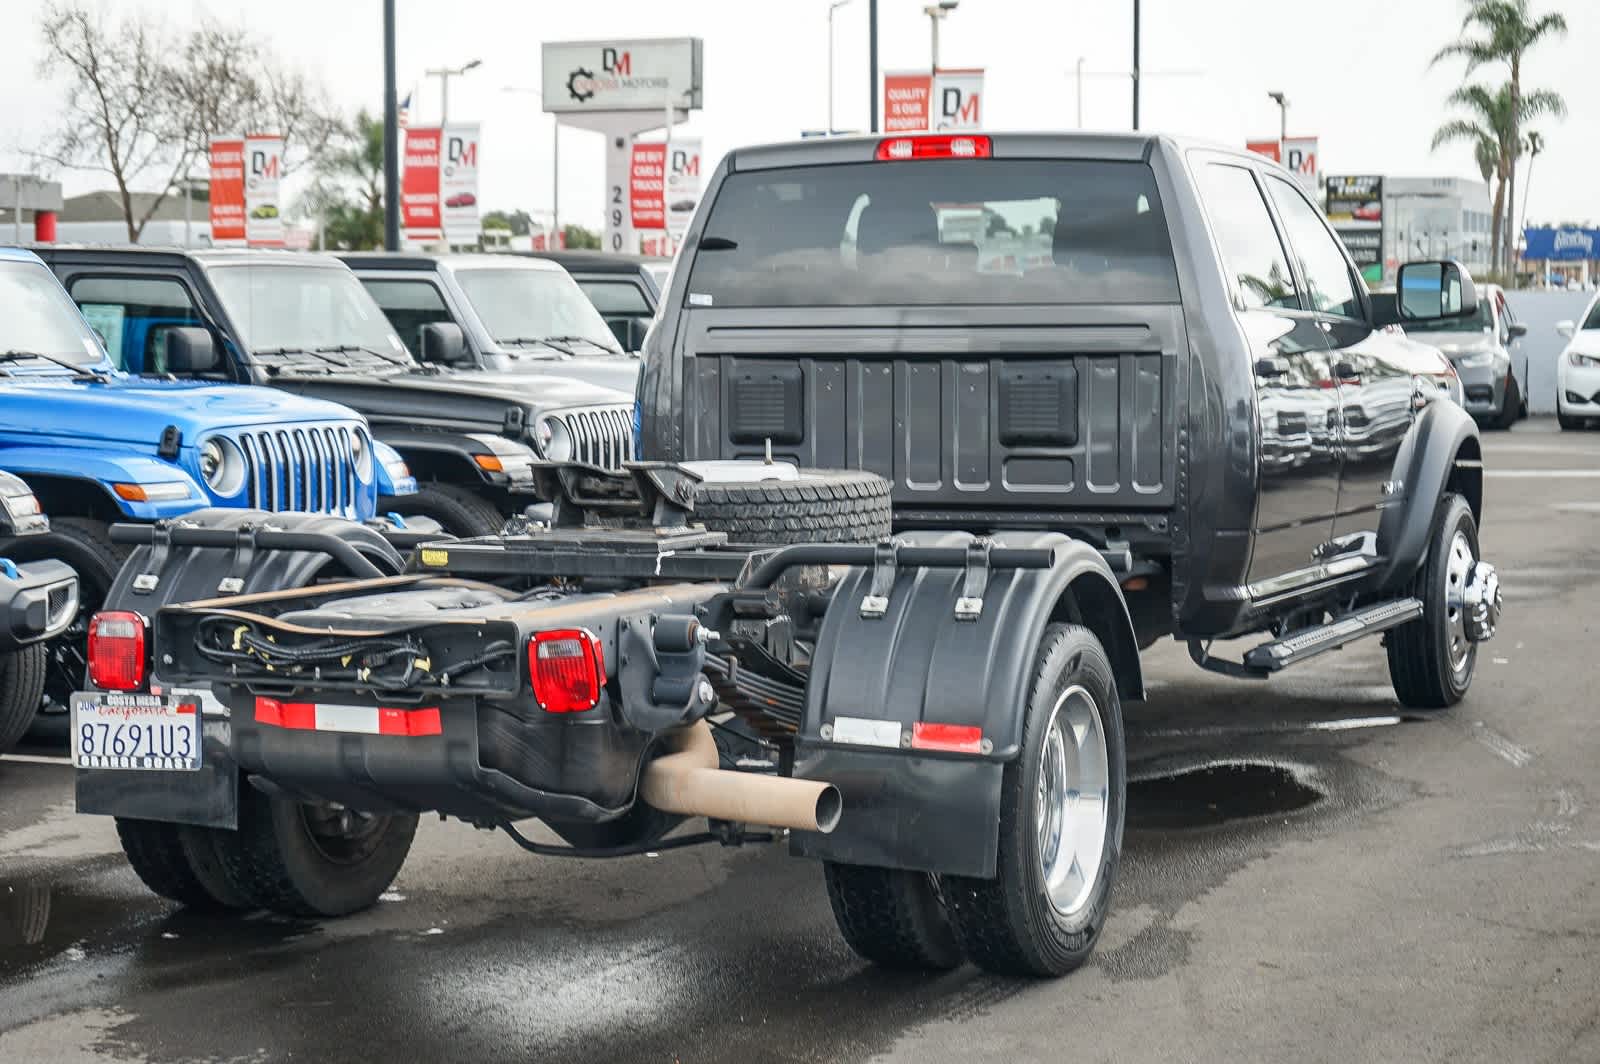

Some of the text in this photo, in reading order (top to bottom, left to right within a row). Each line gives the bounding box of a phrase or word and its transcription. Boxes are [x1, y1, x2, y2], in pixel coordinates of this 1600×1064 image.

[602, 48, 632, 76] DM
[887, 87, 927, 100] QUALITY
[942, 87, 978, 124] DM
[252, 151, 277, 179] DM
[448, 137, 478, 168] DM
[672, 150, 700, 176] DM
[1289, 149, 1315, 176] DM
[79, 701, 96, 711] JUN
[81, 723, 191, 757] 87691U3
[80, 756, 193, 769] ORANGE COAST
